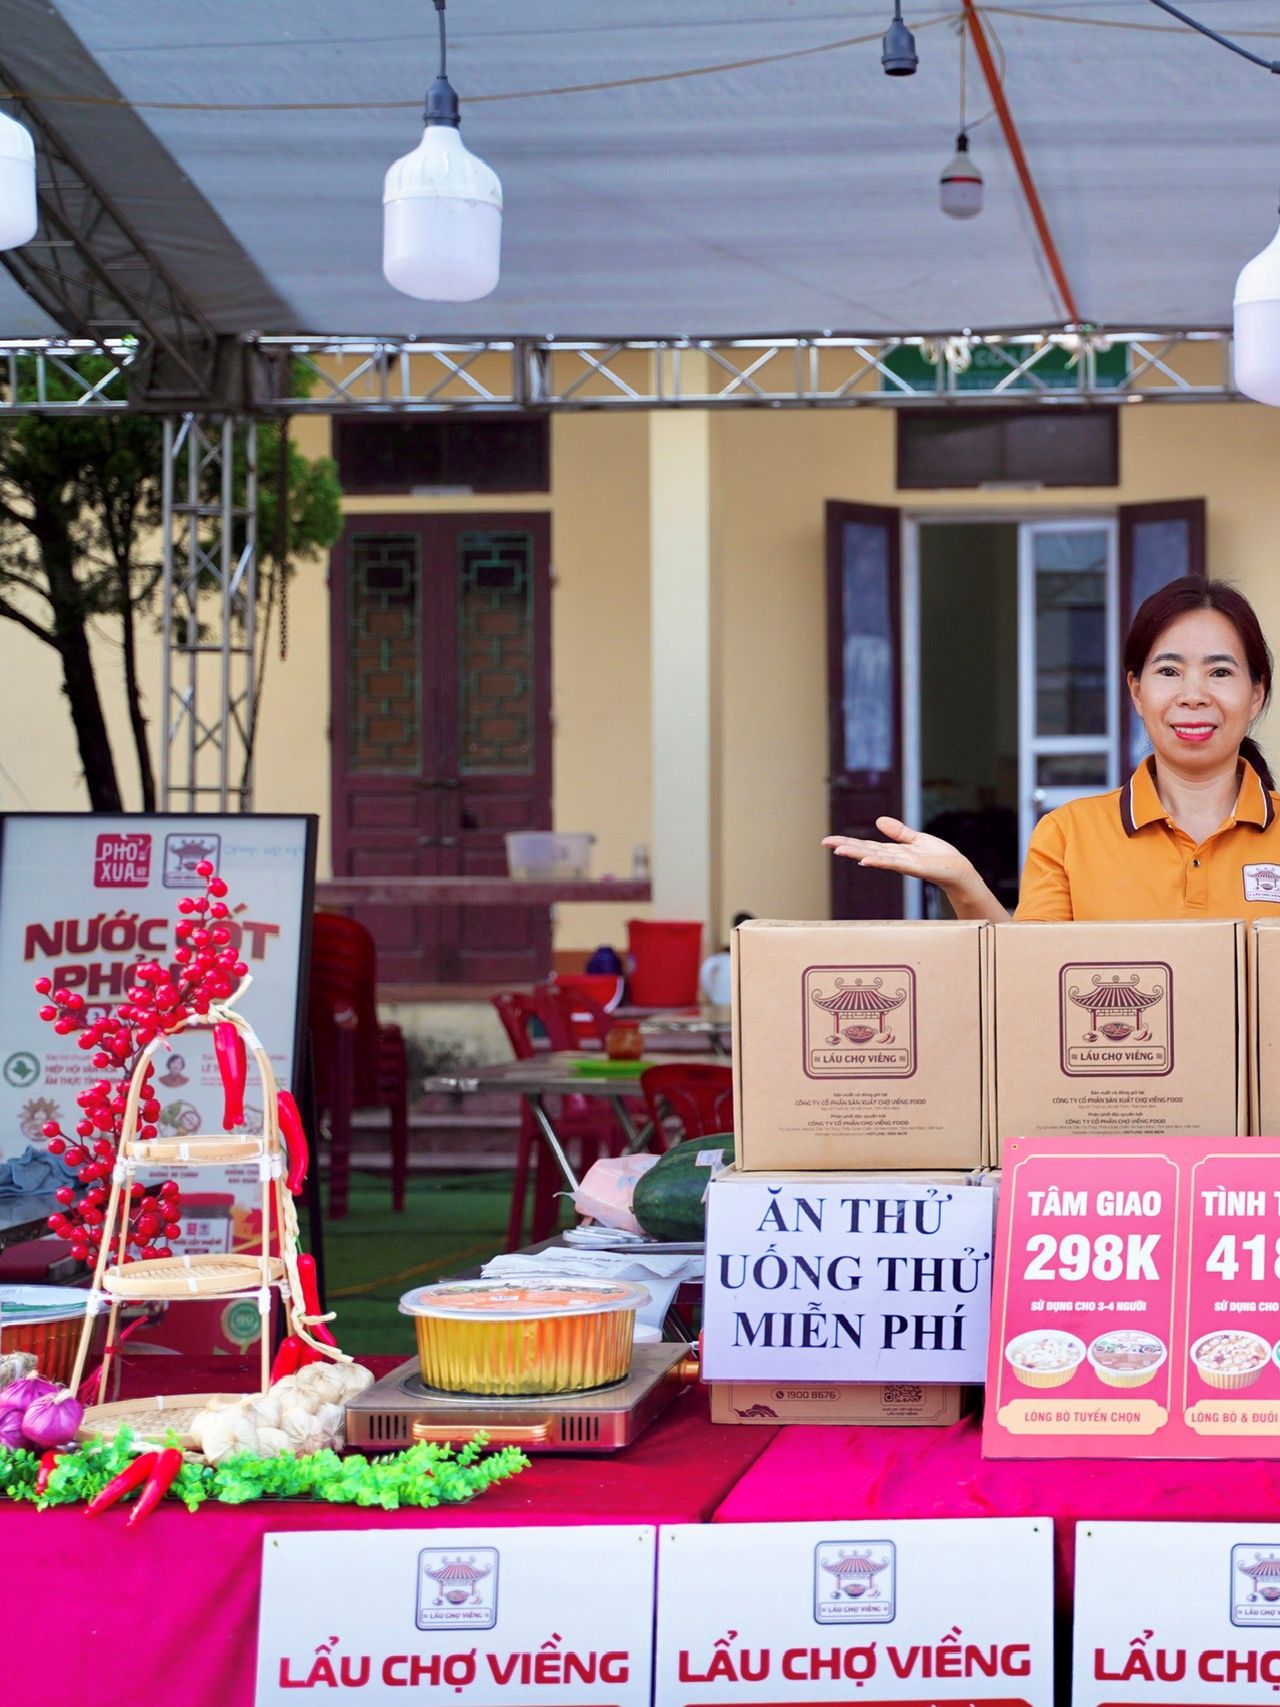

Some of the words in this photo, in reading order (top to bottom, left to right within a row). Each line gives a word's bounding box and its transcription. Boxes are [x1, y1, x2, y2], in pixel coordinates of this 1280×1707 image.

[24, 909, 168, 960] NƯỚC
[756, 1186, 826, 1233] ĂN
[840, 1188, 953, 1235] THỬ
[1028, 1185, 1088, 1217] TÂM
[1096, 1191, 1162, 1217] GIAO
[1201, 1185, 1265, 1217] TÌNH
[718, 1243, 864, 1292] UỐNG
[877, 1247, 990, 1294] THỬ
[1023, 1234, 1162, 1281] 298K
[732, 1302, 866, 1349] MIỄN
[880, 1304, 968, 1351] PHÍ
[1075, 1301, 1095, 1312] CHO
[1098, 1301, 1114, 1312] 3-4
[1258, 1301, 1279, 1312] CHO
[787, 1390, 809, 1400] 1900
[811, 1390, 836, 1400] 8676
[1110, 1411, 1141, 1425] CHỌN
[1241, 1412, 1248, 1423] &
[279, 1636, 371, 1688] LẨU
[382, 1648, 477, 1693] CHỢ
[487, 1632, 629, 1685] VIỀNG
[678, 1630, 770, 1682] LẨU
[782, 1642, 877, 1687] CHỢ
[887, 1626, 1031, 1678] VIỀNG
[1094, 1630, 1186, 1681] LẨU
